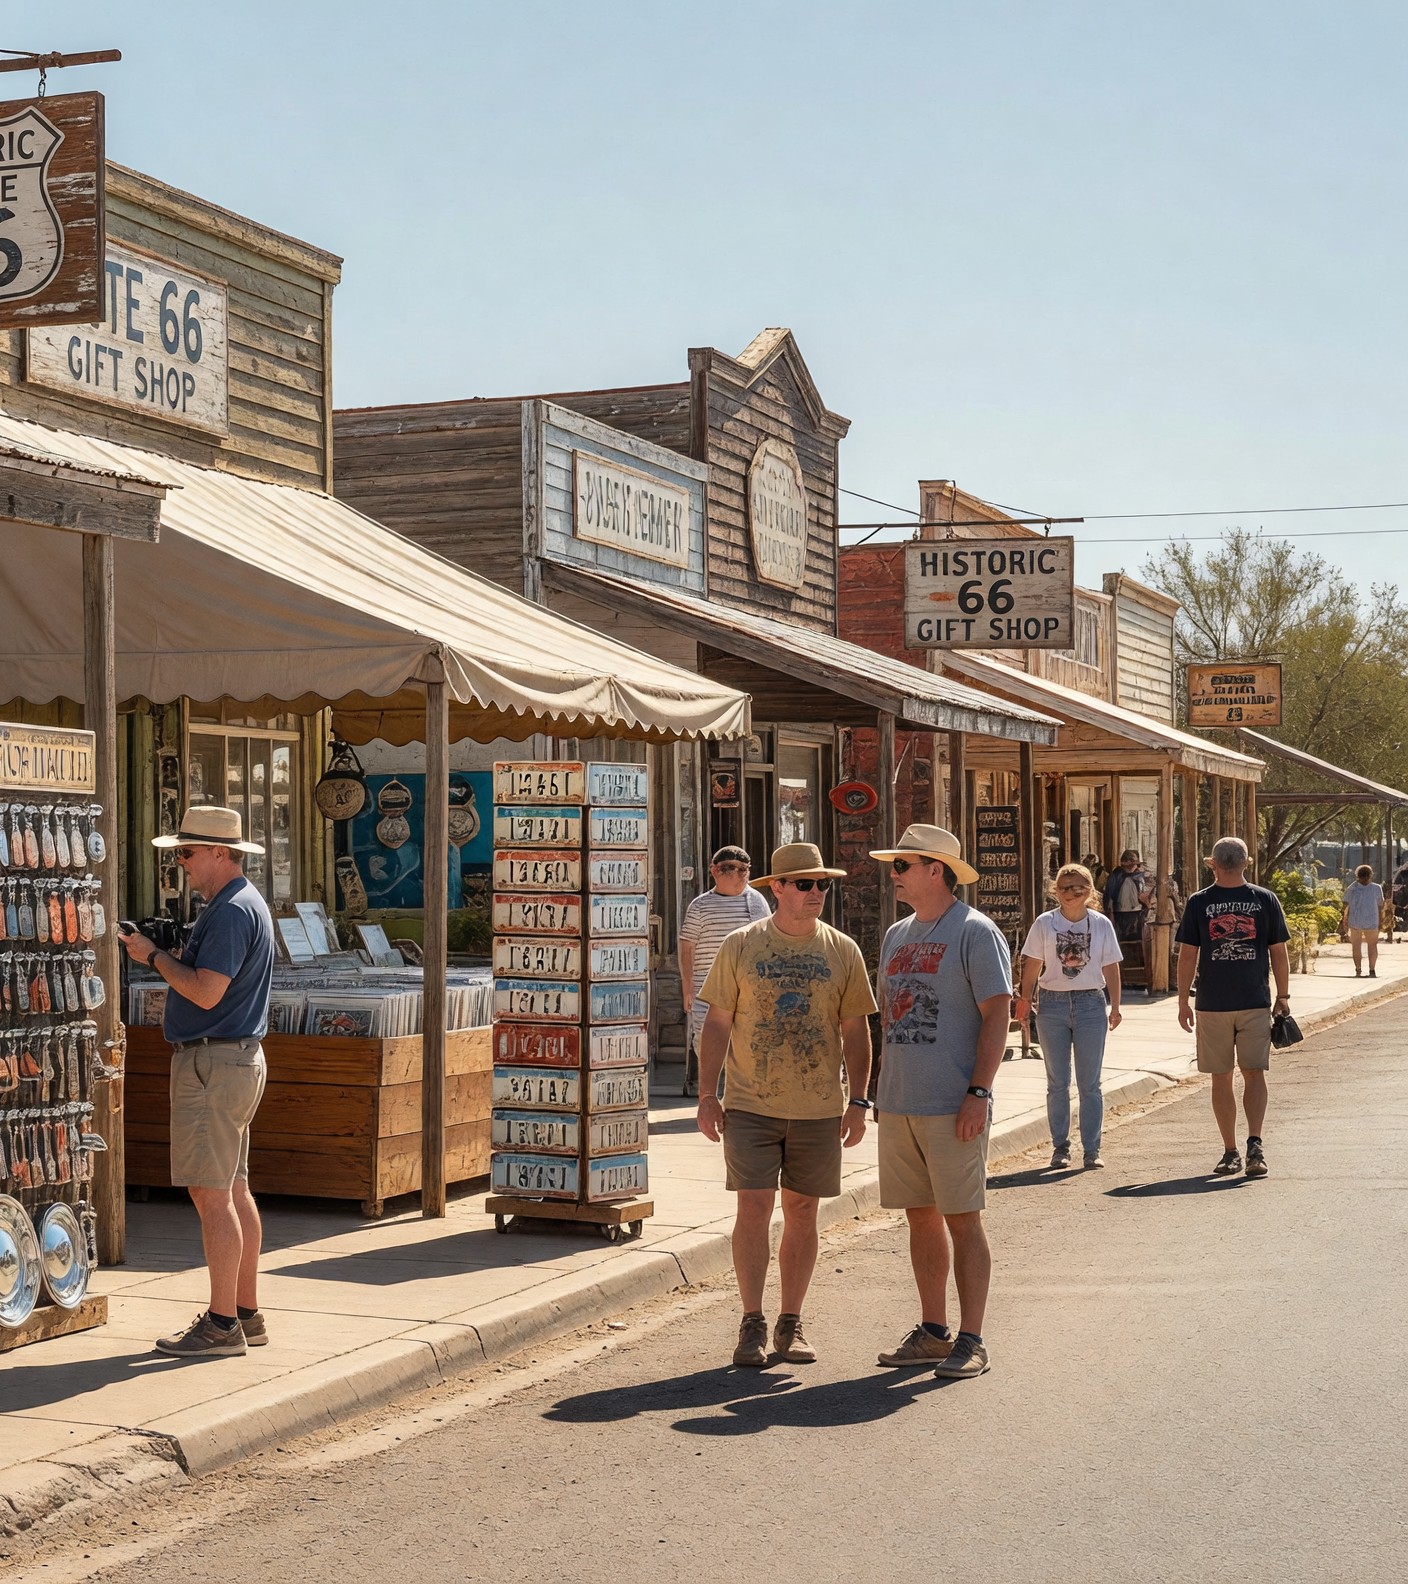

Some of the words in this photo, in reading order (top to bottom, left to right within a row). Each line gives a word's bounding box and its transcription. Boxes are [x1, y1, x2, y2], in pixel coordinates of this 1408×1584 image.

[159, 279, 203, 364] 66
[68, 335, 123, 391] GIFT
[134, 356, 196, 412] SHOP
[920, 548, 1056, 576] HISTORIC
[957, 579, 1015, 615] 66
[917, 618, 975, 642] GIFT
[989, 617, 1059, 640] SHOP
